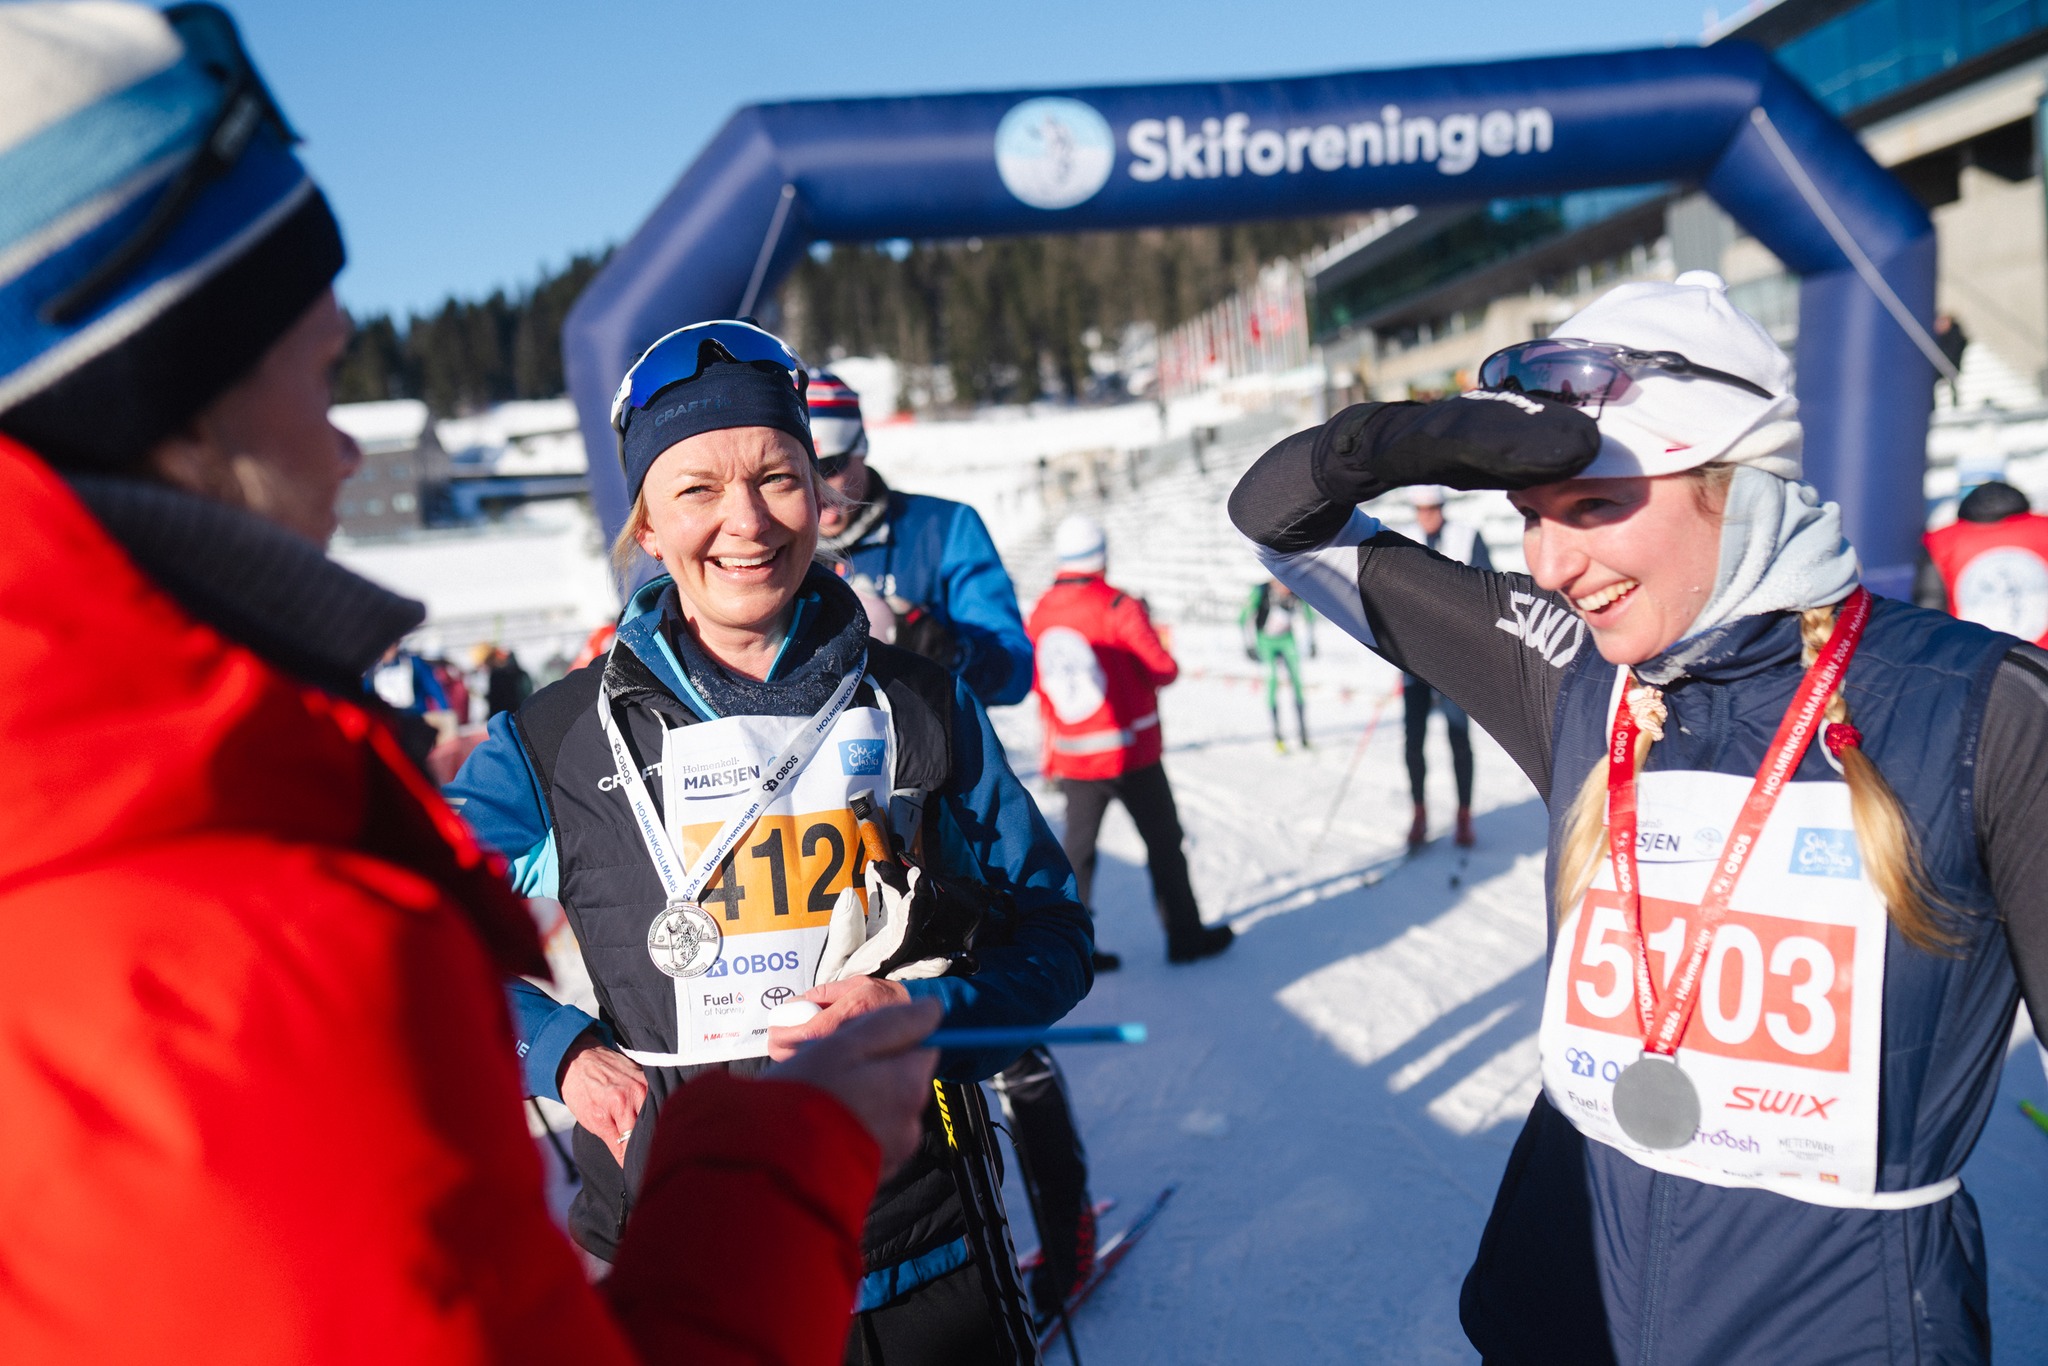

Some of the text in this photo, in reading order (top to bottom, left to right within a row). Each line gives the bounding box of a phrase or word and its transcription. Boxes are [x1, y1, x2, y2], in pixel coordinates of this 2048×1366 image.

[1127, 105, 1554, 183] Skiforeningen
[654, 398, 712, 427] CRAFT
[1761, 662, 1841, 796] HOLMENKOLLMARSJEN
[1832, 639, 1851, 663] 2026
[848, 743, 868, 756] Ski
[1613, 730, 1629, 764] OBOS
[597, 762, 662, 792] CRFT
[618, 755, 633, 785] OBOS
[683, 757, 740, 774] Holmenkoll-
[684, 765, 760, 790] MARSJEN
[775, 755, 799, 781] OBOS
[682, 878, 701, 901] 2026
[703, 802, 760, 872] Ungdomsmarsjen
[1724, 834, 1752, 874] OBOS
[1616, 853, 1633, 893] OBOS
[733, 951, 799, 975] OBOS
[703, 993, 733, 1006] Fuel
[1661, 1011, 1681, 1043] 2026
[1675, 928, 1711, 1001] Halvmarsjen
[704, 1007, 712, 1016] of
[933, 1078, 958, 1150] WIX
[1568, 1090, 1598, 1111] Fuel
[1725, 1086, 1839, 1119] SWIX
